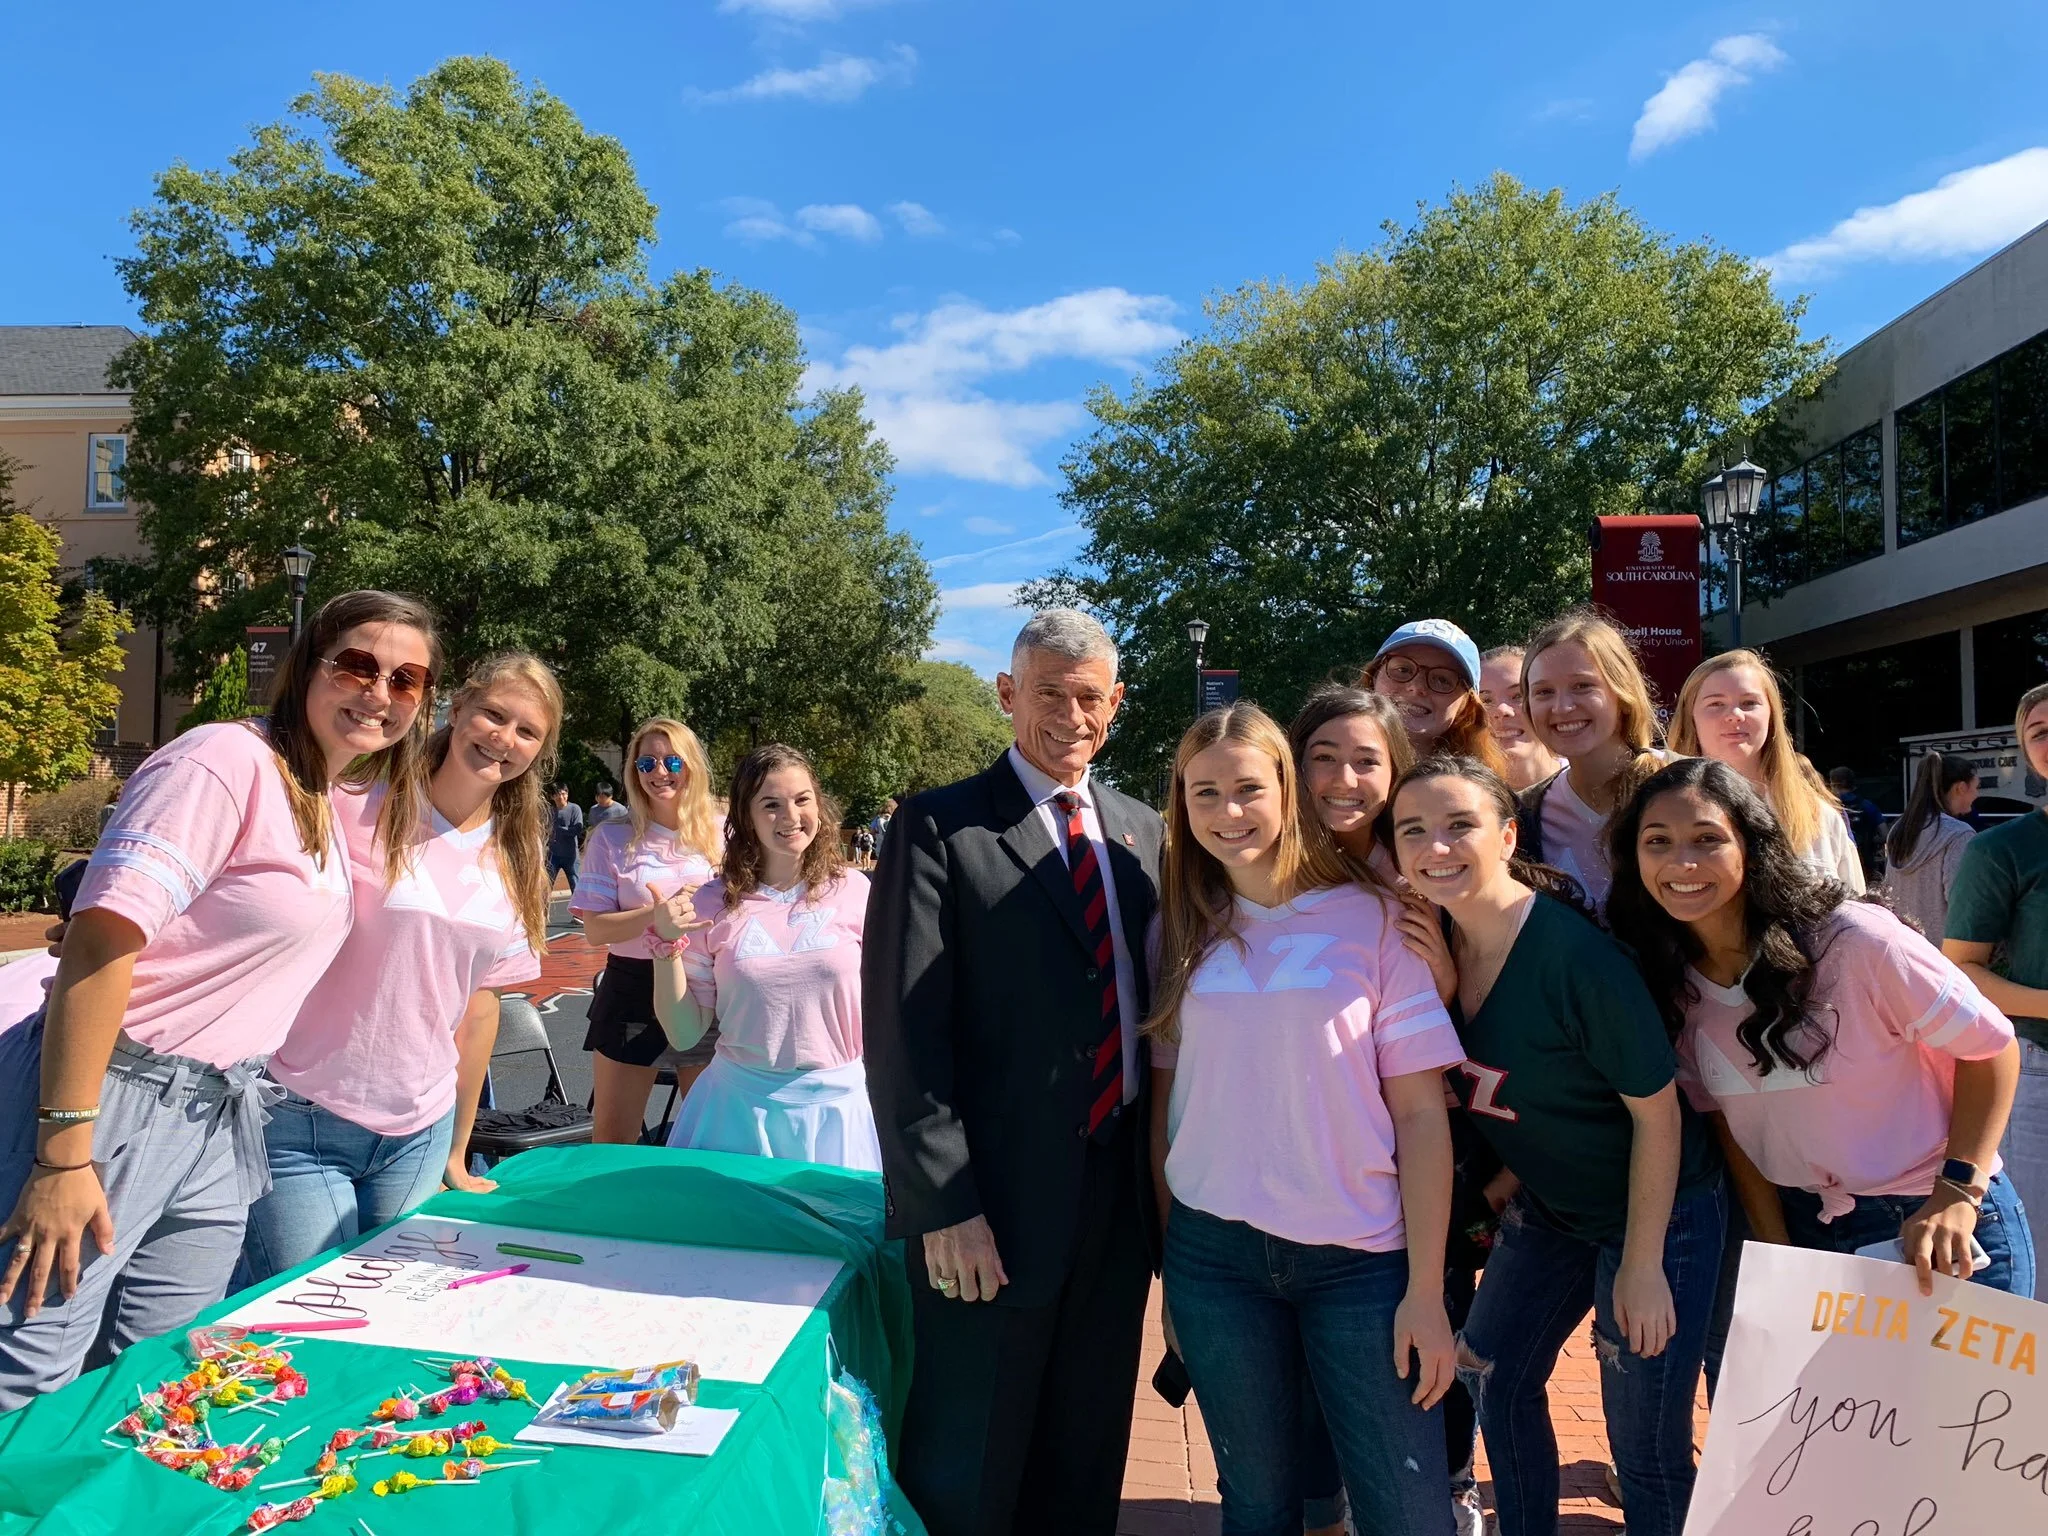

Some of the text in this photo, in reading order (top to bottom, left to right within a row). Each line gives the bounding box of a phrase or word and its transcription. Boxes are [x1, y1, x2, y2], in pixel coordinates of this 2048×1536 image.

[1606, 570, 1695, 581] SOUTH CAROLINA
[1650, 627, 1682, 636] House
[250, 641, 267, 653] 47
[1664, 637, 1694, 646] Union
[385, 1284, 413, 1294] TO
[1811, 1290, 2038, 1376] DELTA ZETA
[1737, 1386, 1912, 1496] you
